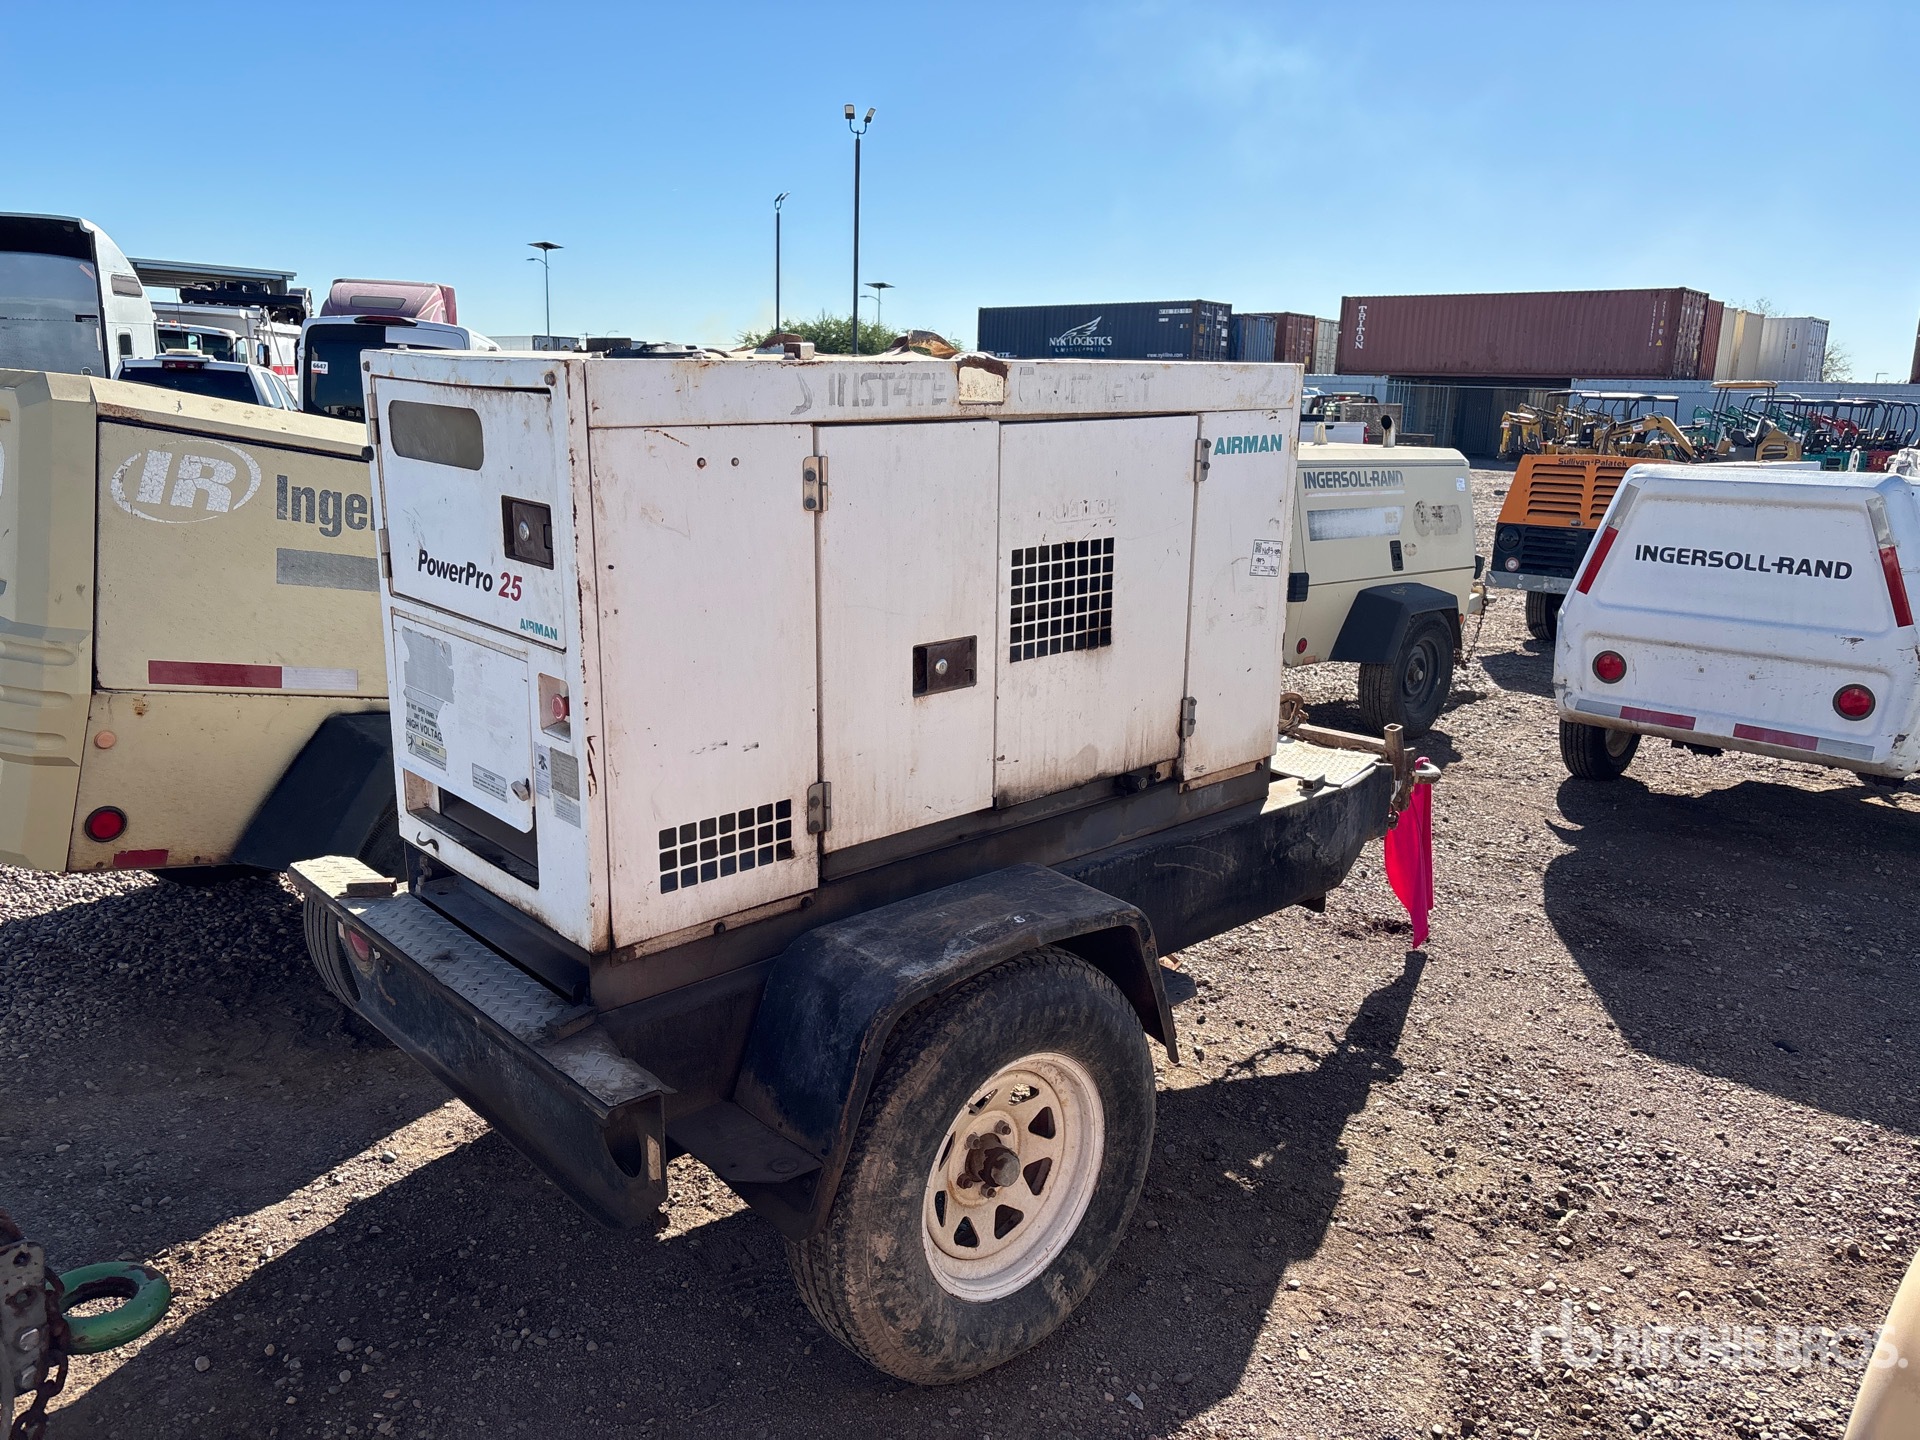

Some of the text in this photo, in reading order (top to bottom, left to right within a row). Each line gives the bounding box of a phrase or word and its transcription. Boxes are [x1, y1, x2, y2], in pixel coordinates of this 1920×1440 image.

[1354, 305, 1368, 350] TRITON
[1049, 336, 1113, 347] NYK LOGISTICS
[312, 362, 327, 370] 6647
[1213, 433, 1283, 456] AIRMAN
[135, 449, 238, 514] IR
[1303, 470, 1405, 490] INGERSOLL-RAND
[1384, 511, 1399, 525] 185
[1635, 543, 1853, 580] INGERSOLL-RAND
[417, 548, 523, 602] PowerPro 25
[519, 617, 558, 641] AIRMAN
[419, 722, 443, 742] VOLTAG
